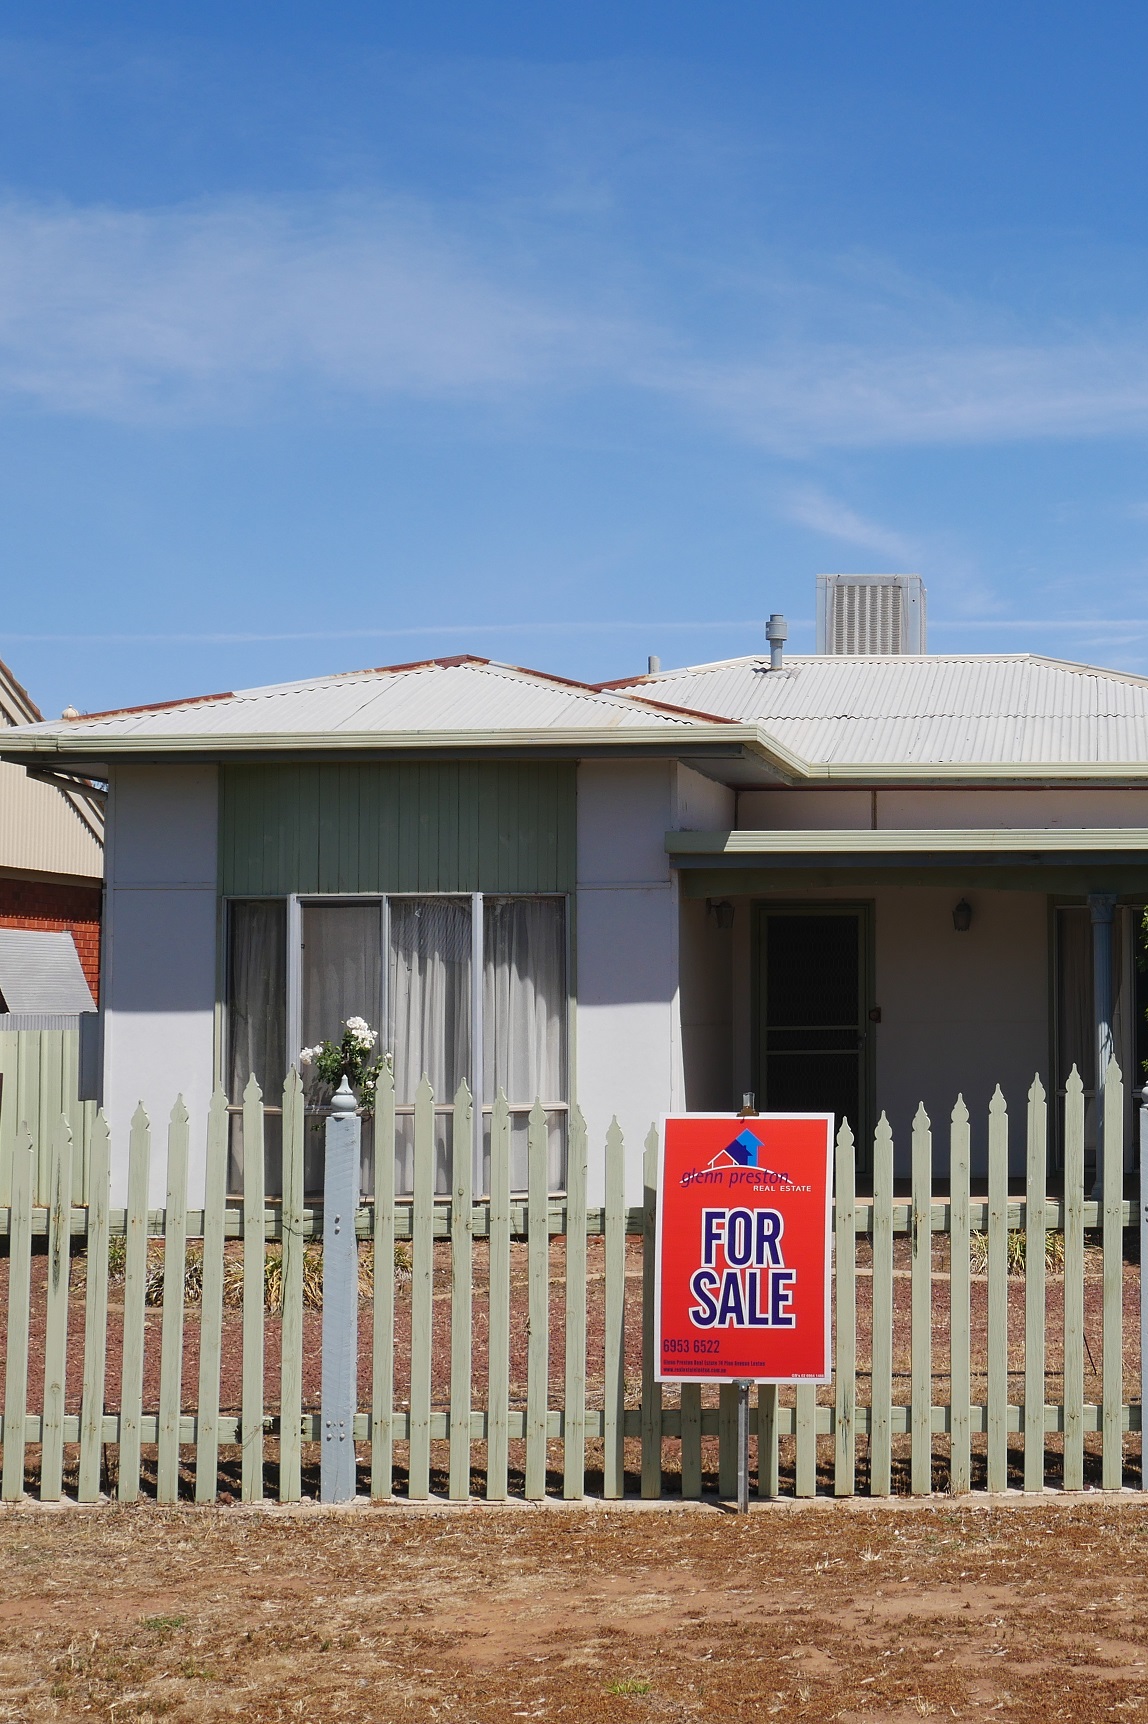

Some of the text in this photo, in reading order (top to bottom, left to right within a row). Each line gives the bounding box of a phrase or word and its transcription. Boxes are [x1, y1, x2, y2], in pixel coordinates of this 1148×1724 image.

[681, 1168, 789, 1188] glenn preston
[702, 1208, 784, 1268] FOR
[690, 1267, 796, 1329] SALE
[663, 1339, 720, 1354] 6953 6522
